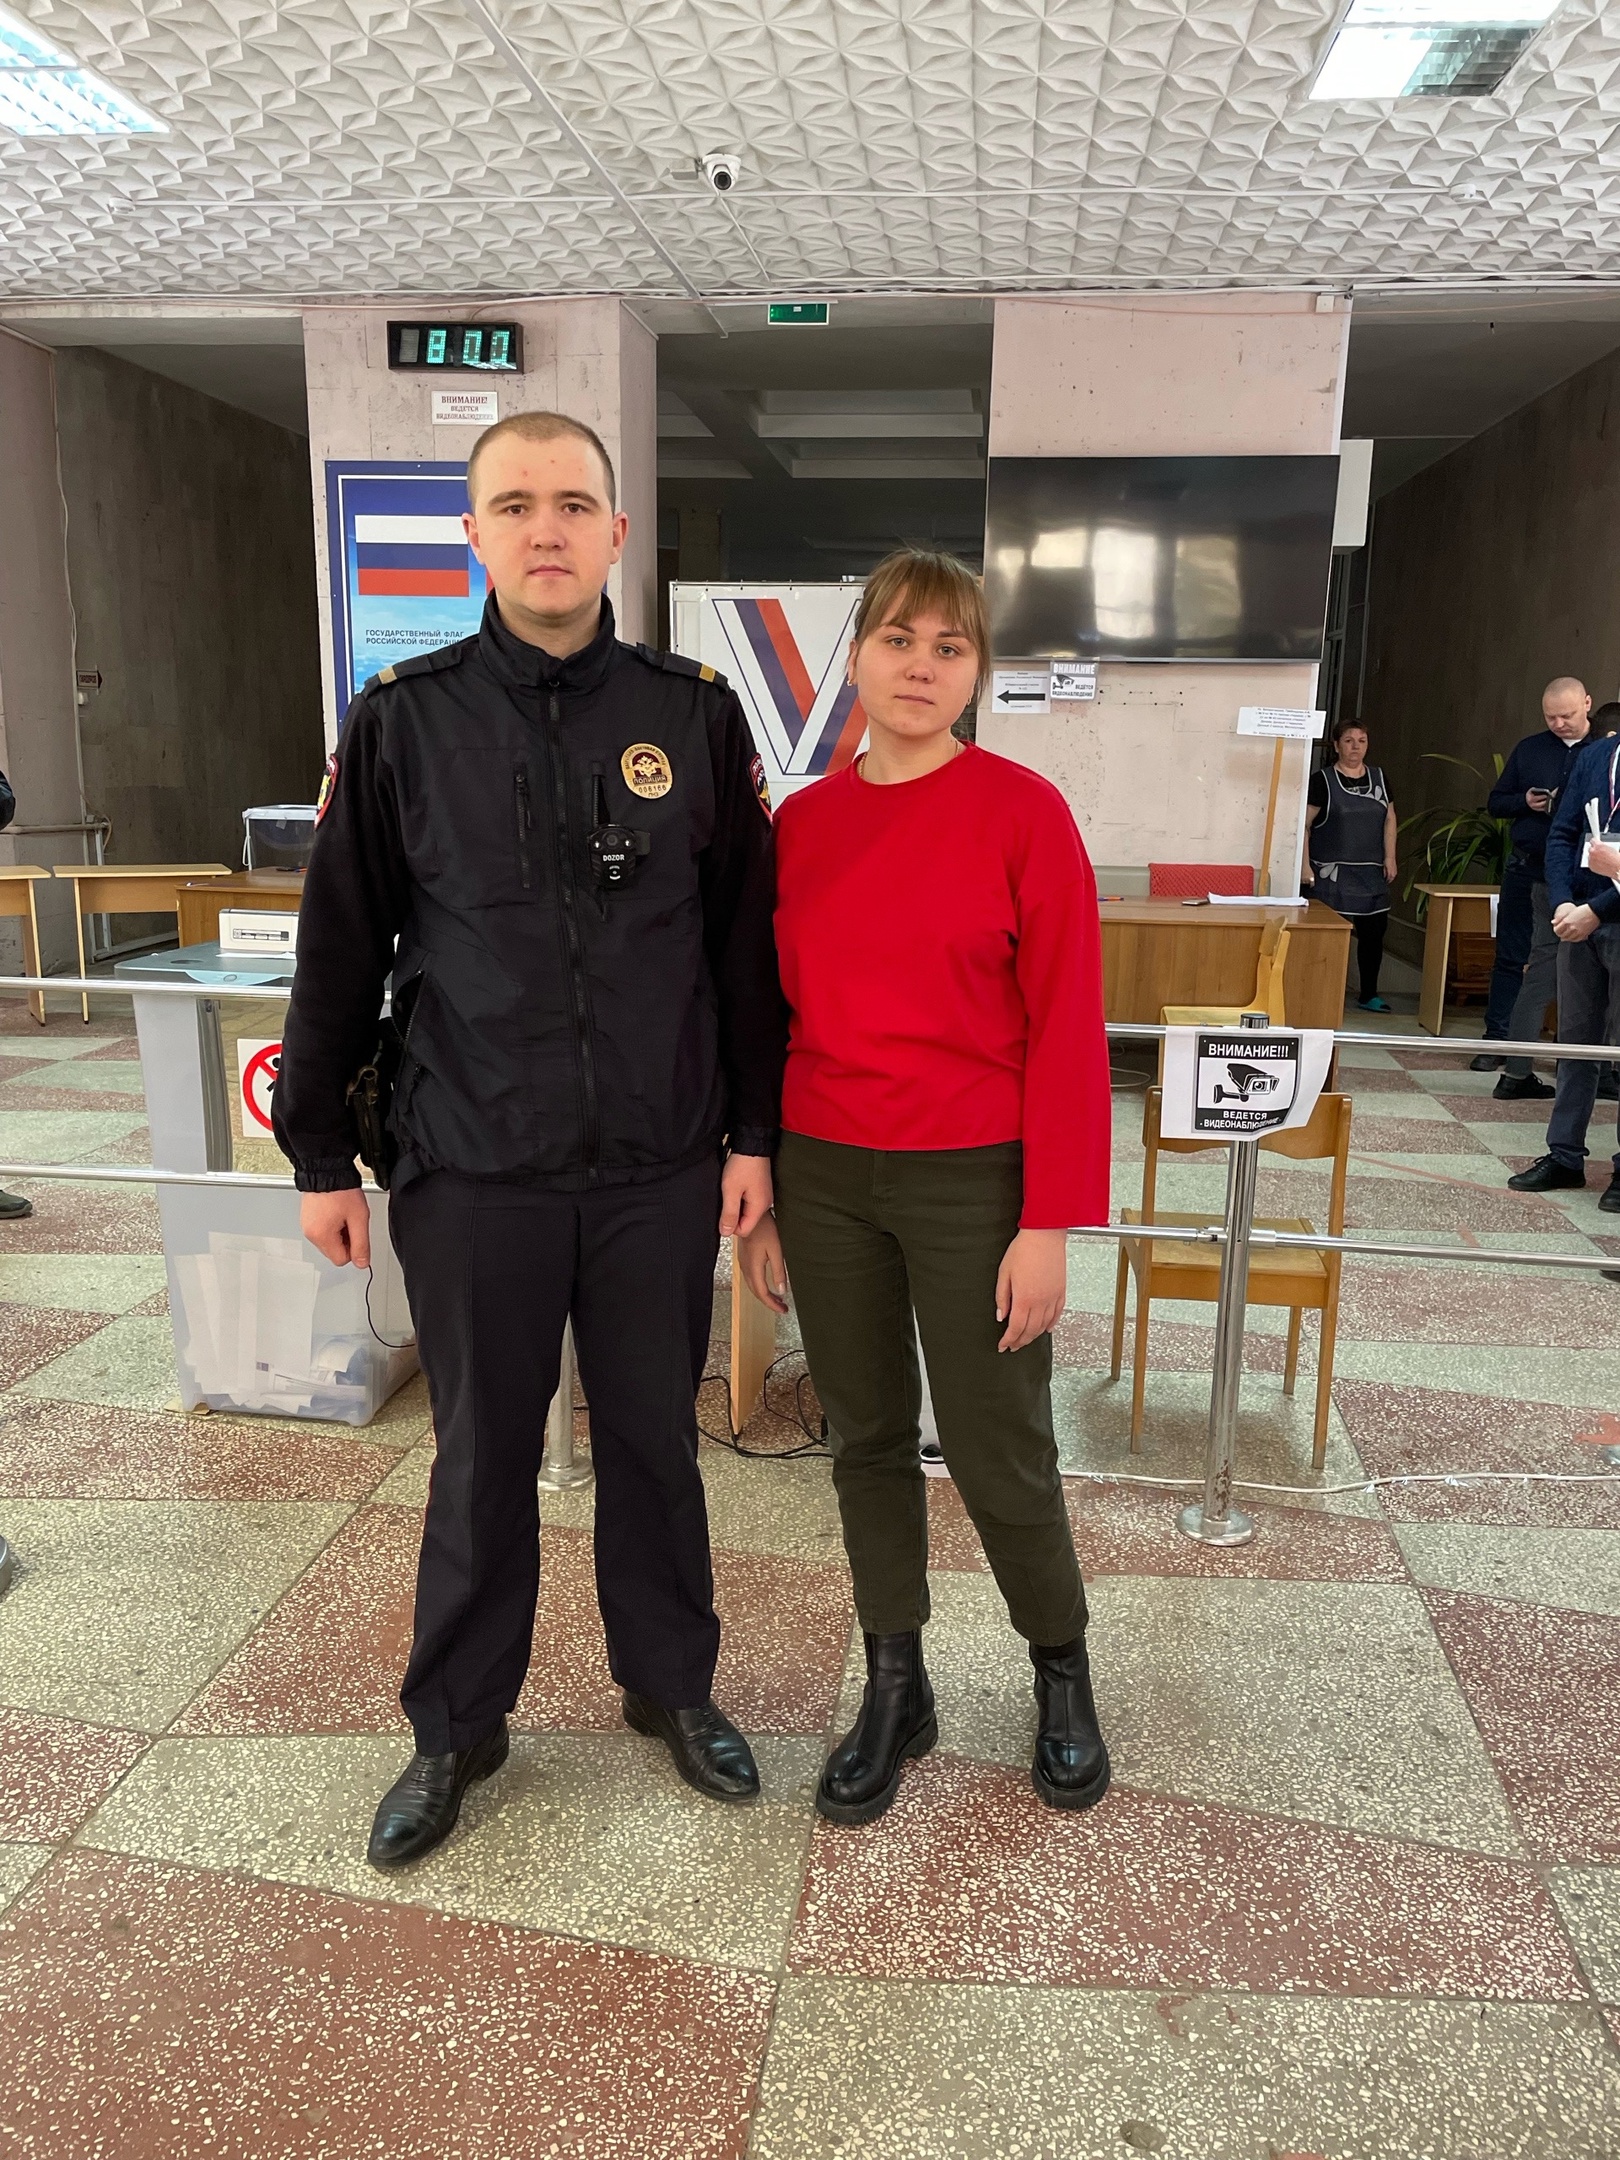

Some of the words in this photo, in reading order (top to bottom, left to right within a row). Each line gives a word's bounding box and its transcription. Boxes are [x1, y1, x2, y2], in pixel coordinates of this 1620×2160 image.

[441, 396, 488, 404] ВНИМАНИЕ!
[366, 629, 441, 637] ГОСУДАРСТВЕННЫЙ
[366, 637, 417, 645] РОССИЙСКОЙ
[1053, 663, 1096, 675] ВНИМАНИЕ
[633, 775, 667, 785] ПОЛИЦИЯ
[602, 854, 625, 862] DOZOR
[1208, 1043, 1289, 1058] ВНИМАНИЕ!!!
[1223, 1110, 1268, 1120] ВЕДЕТСЯ
